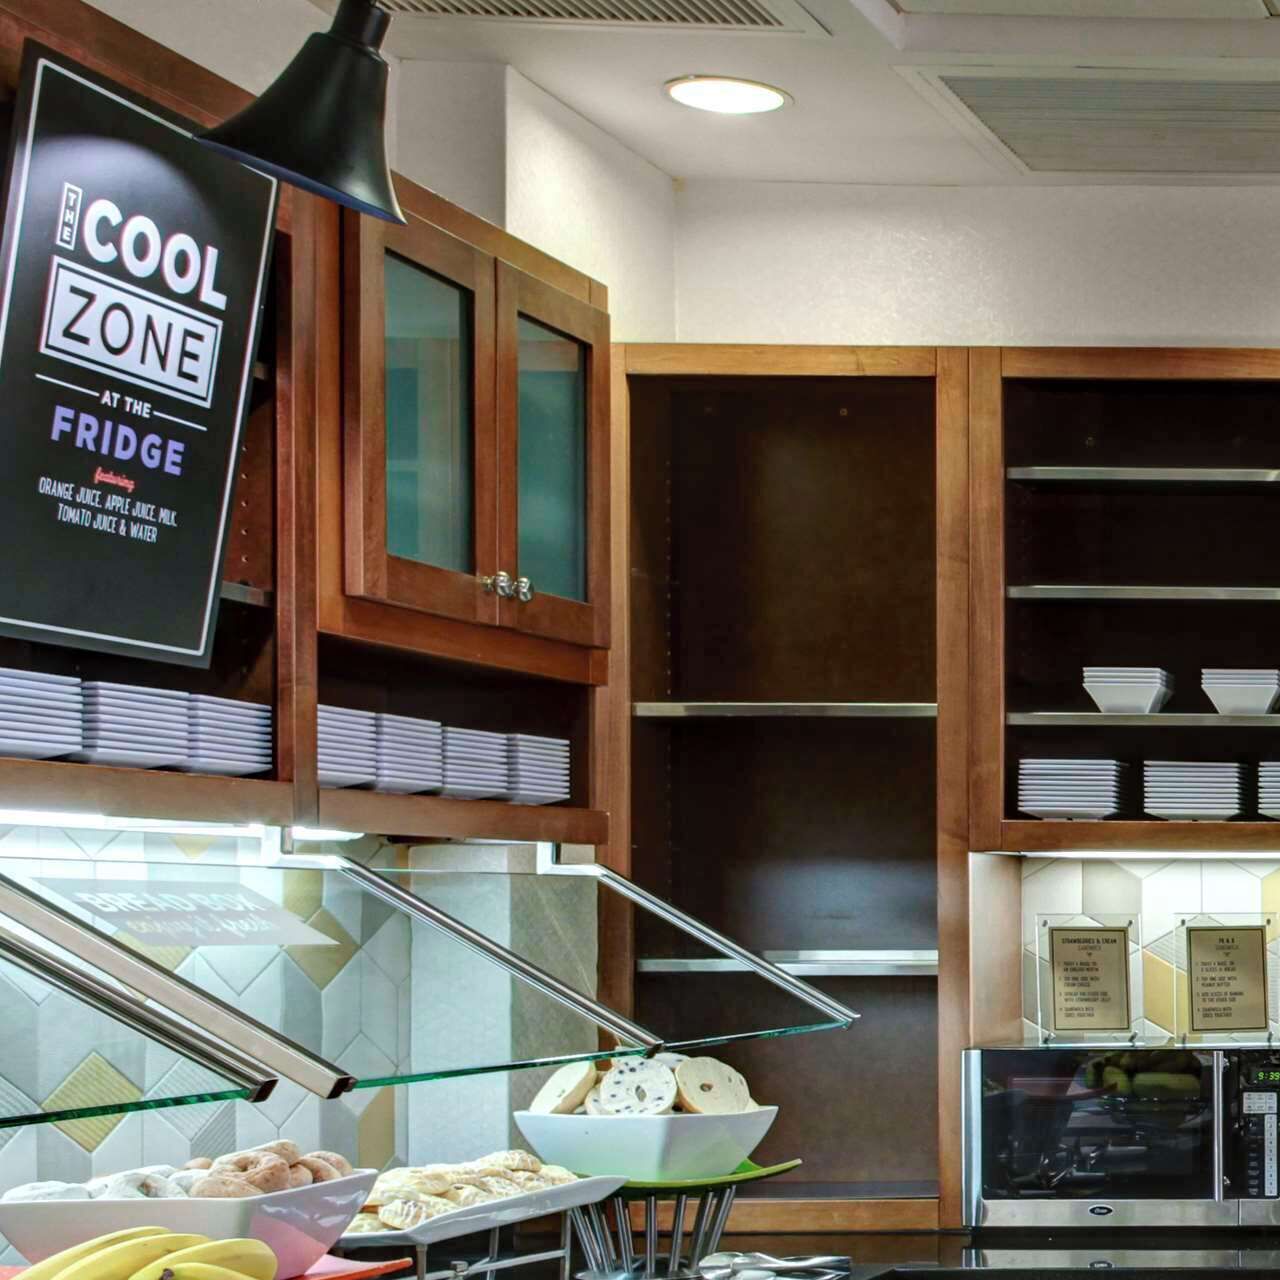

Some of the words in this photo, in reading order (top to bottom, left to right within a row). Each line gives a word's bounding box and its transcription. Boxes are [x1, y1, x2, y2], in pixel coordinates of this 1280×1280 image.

[62, 191, 78, 241] THE
[84, 199, 227, 311] COOL
[62, 285, 206, 383] ZONE
[101, 390, 120, 408] AT
[125, 396, 152, 418] THE
[51, 404, 185, 476] FRIDGE
[38, 476, 75, 501] ORANGE
[105, 494, 131, 515] APPLE
[57, 502, 92, 527] TOMATO
[93, 513, 118, 534] JUICE
[119, 519, 126, 537] &
[130, 521, 158, 543] WATER
[77, 892, 197, 912] BREAD
[188, 893, 267, 912] BOX
[1258, 1071, 1280, 1081] 9:39
